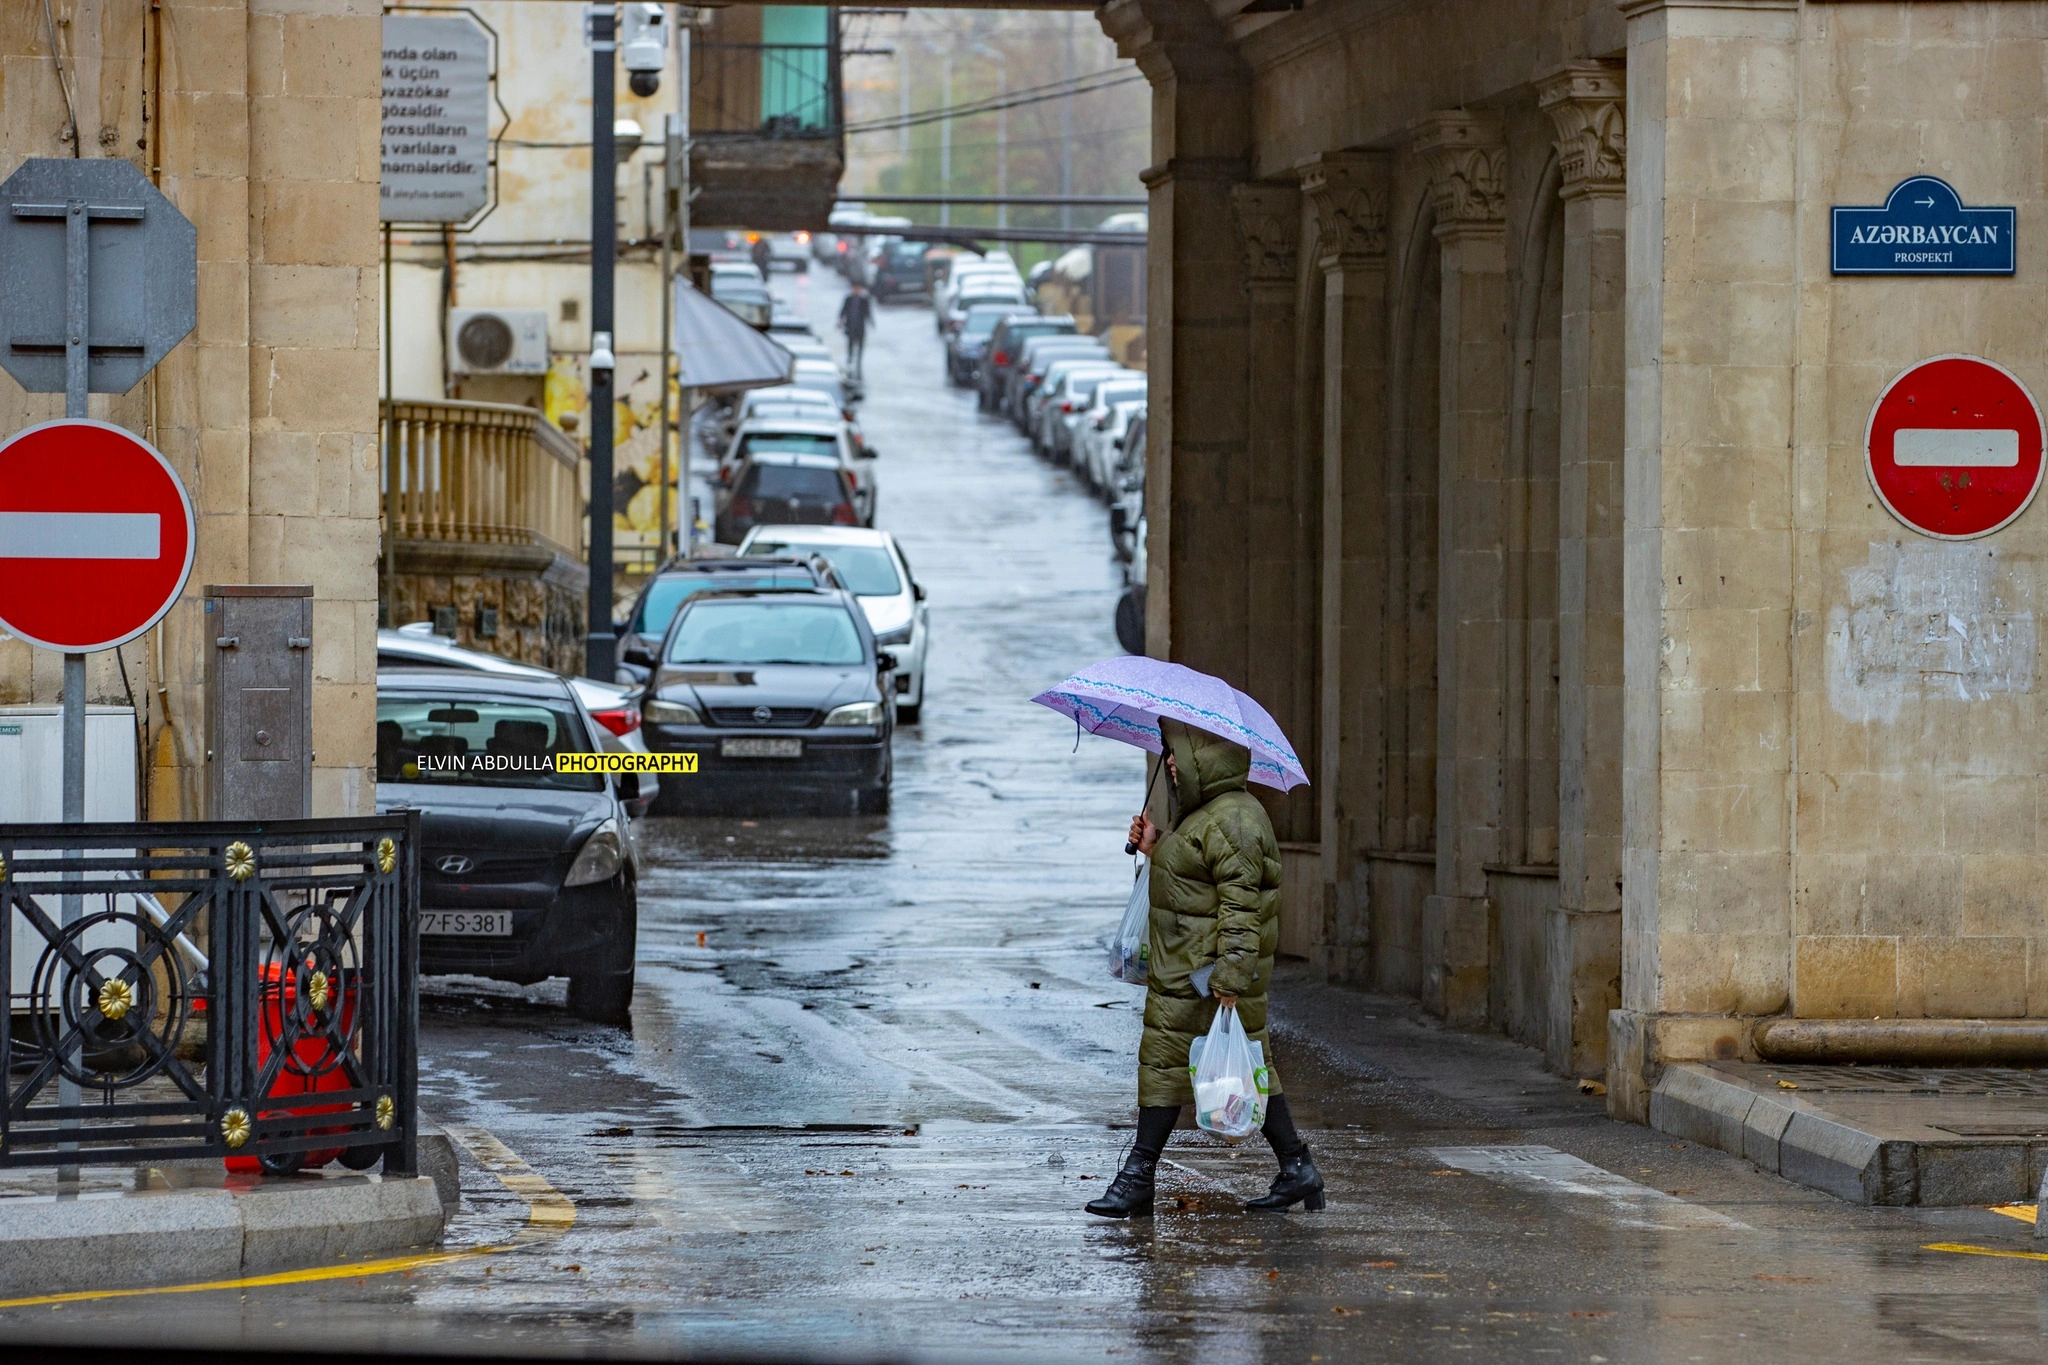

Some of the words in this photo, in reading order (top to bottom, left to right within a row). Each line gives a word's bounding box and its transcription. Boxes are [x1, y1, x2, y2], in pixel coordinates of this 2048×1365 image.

[422, 48, 458, 61] olan
[399, 66, 440, 81] üçün
[1850, 225, 1998, 244] AZƏRBAYCAN
[1894, 251, 1953, 263] PROSPEKTİ
